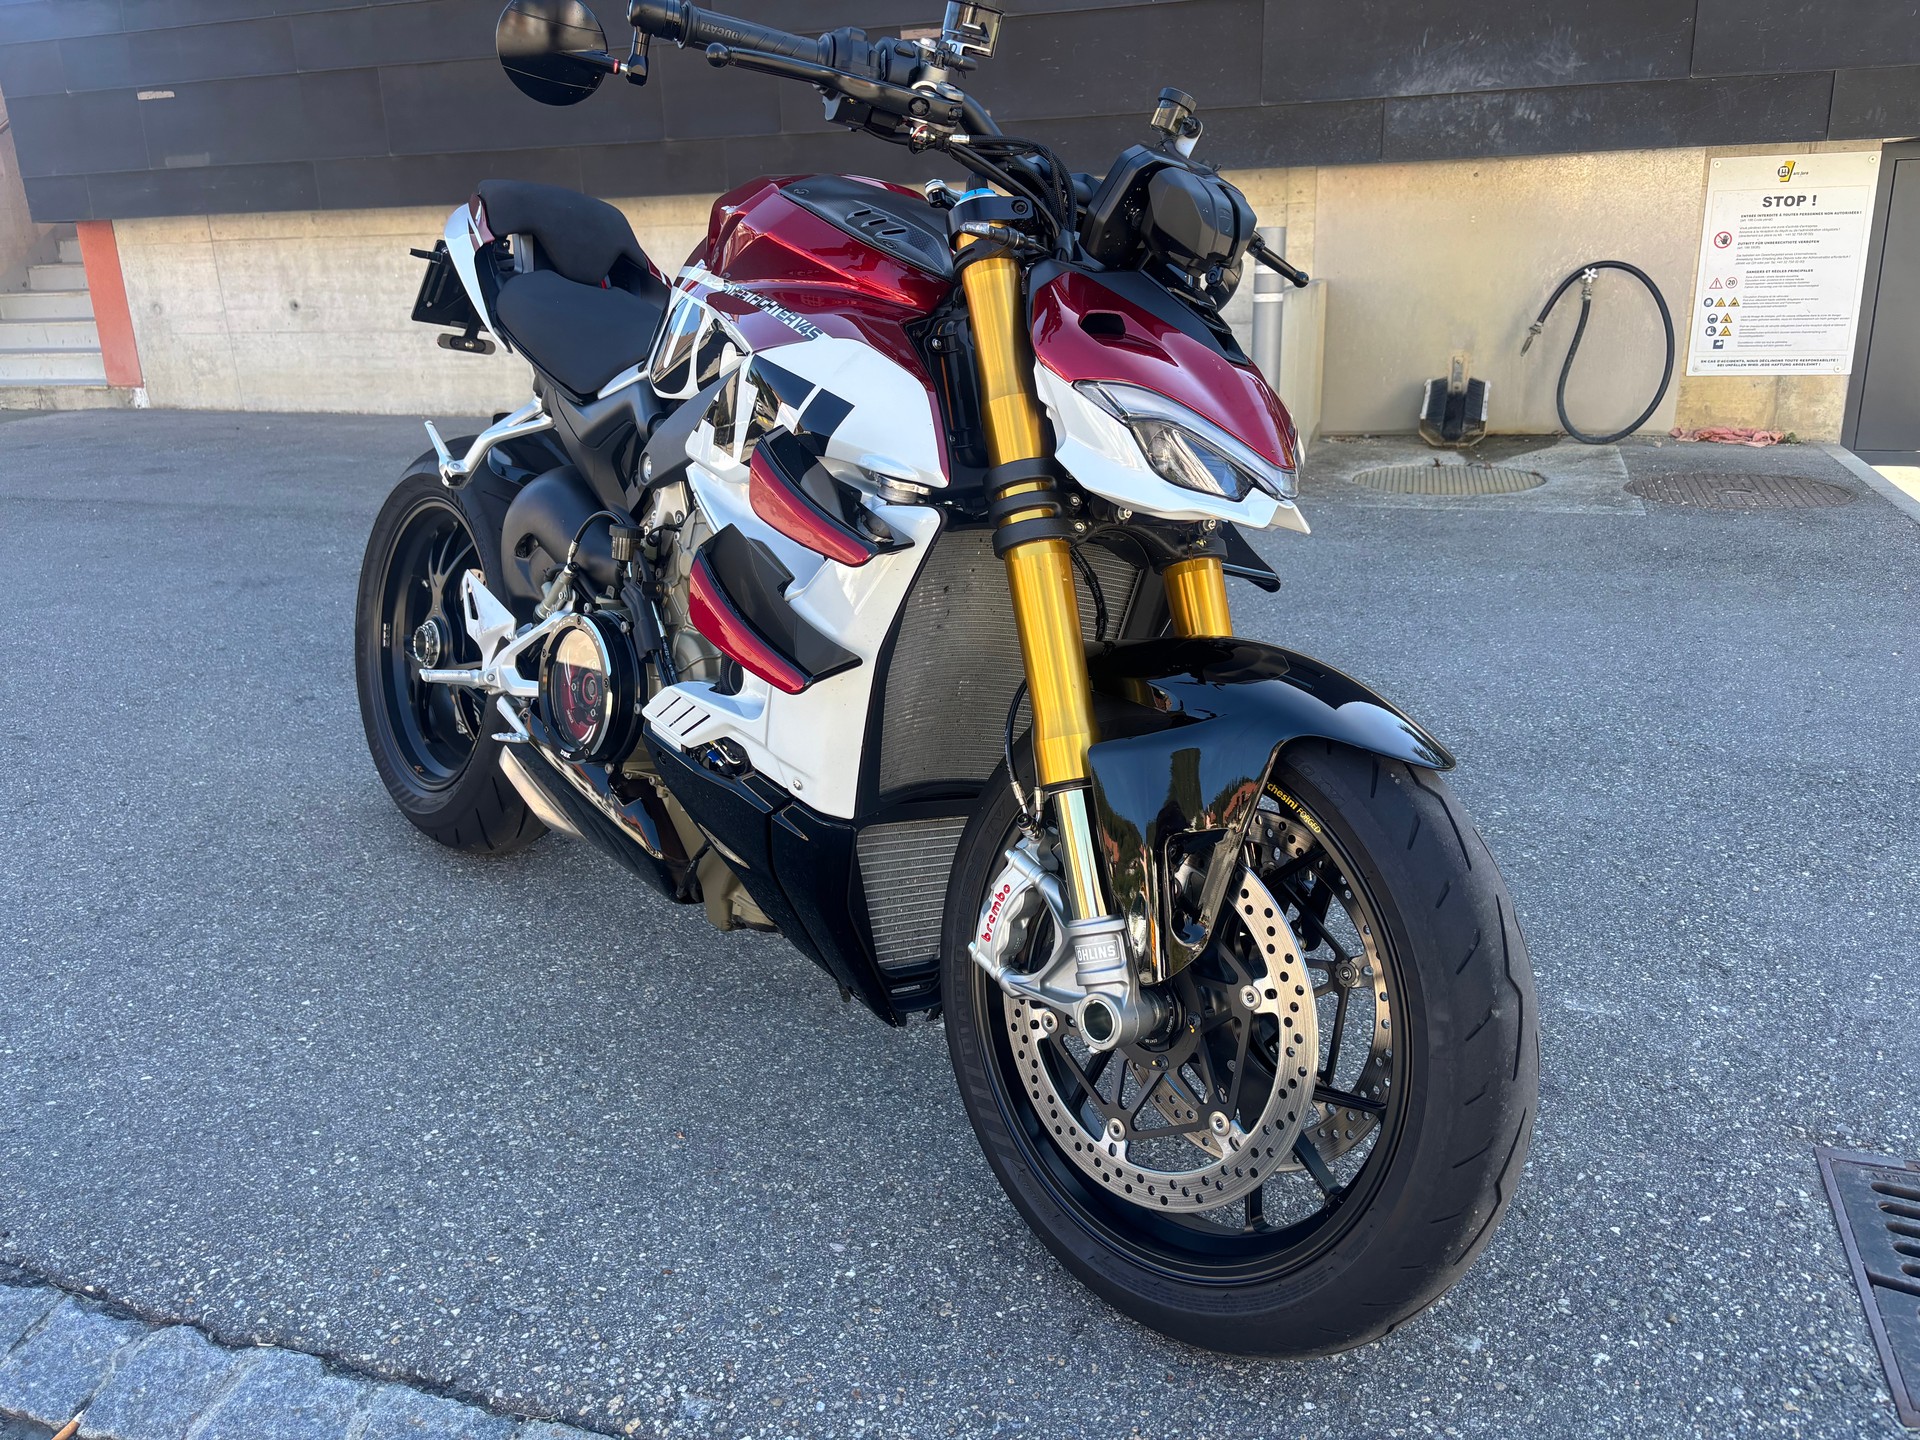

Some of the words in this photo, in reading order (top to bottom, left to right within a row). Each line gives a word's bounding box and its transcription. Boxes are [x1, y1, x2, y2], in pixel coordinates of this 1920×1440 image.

[700, 22, 740, 40] DUCATI
[1762, 195, 1807, 208] STOP
[1812, 194, 1818, 206] !
[1296, 807, 1322, 833] FORGED
[981, 884, 1010, 942] brembo
[1076, 946, 1116, 961] ÖHLINS
